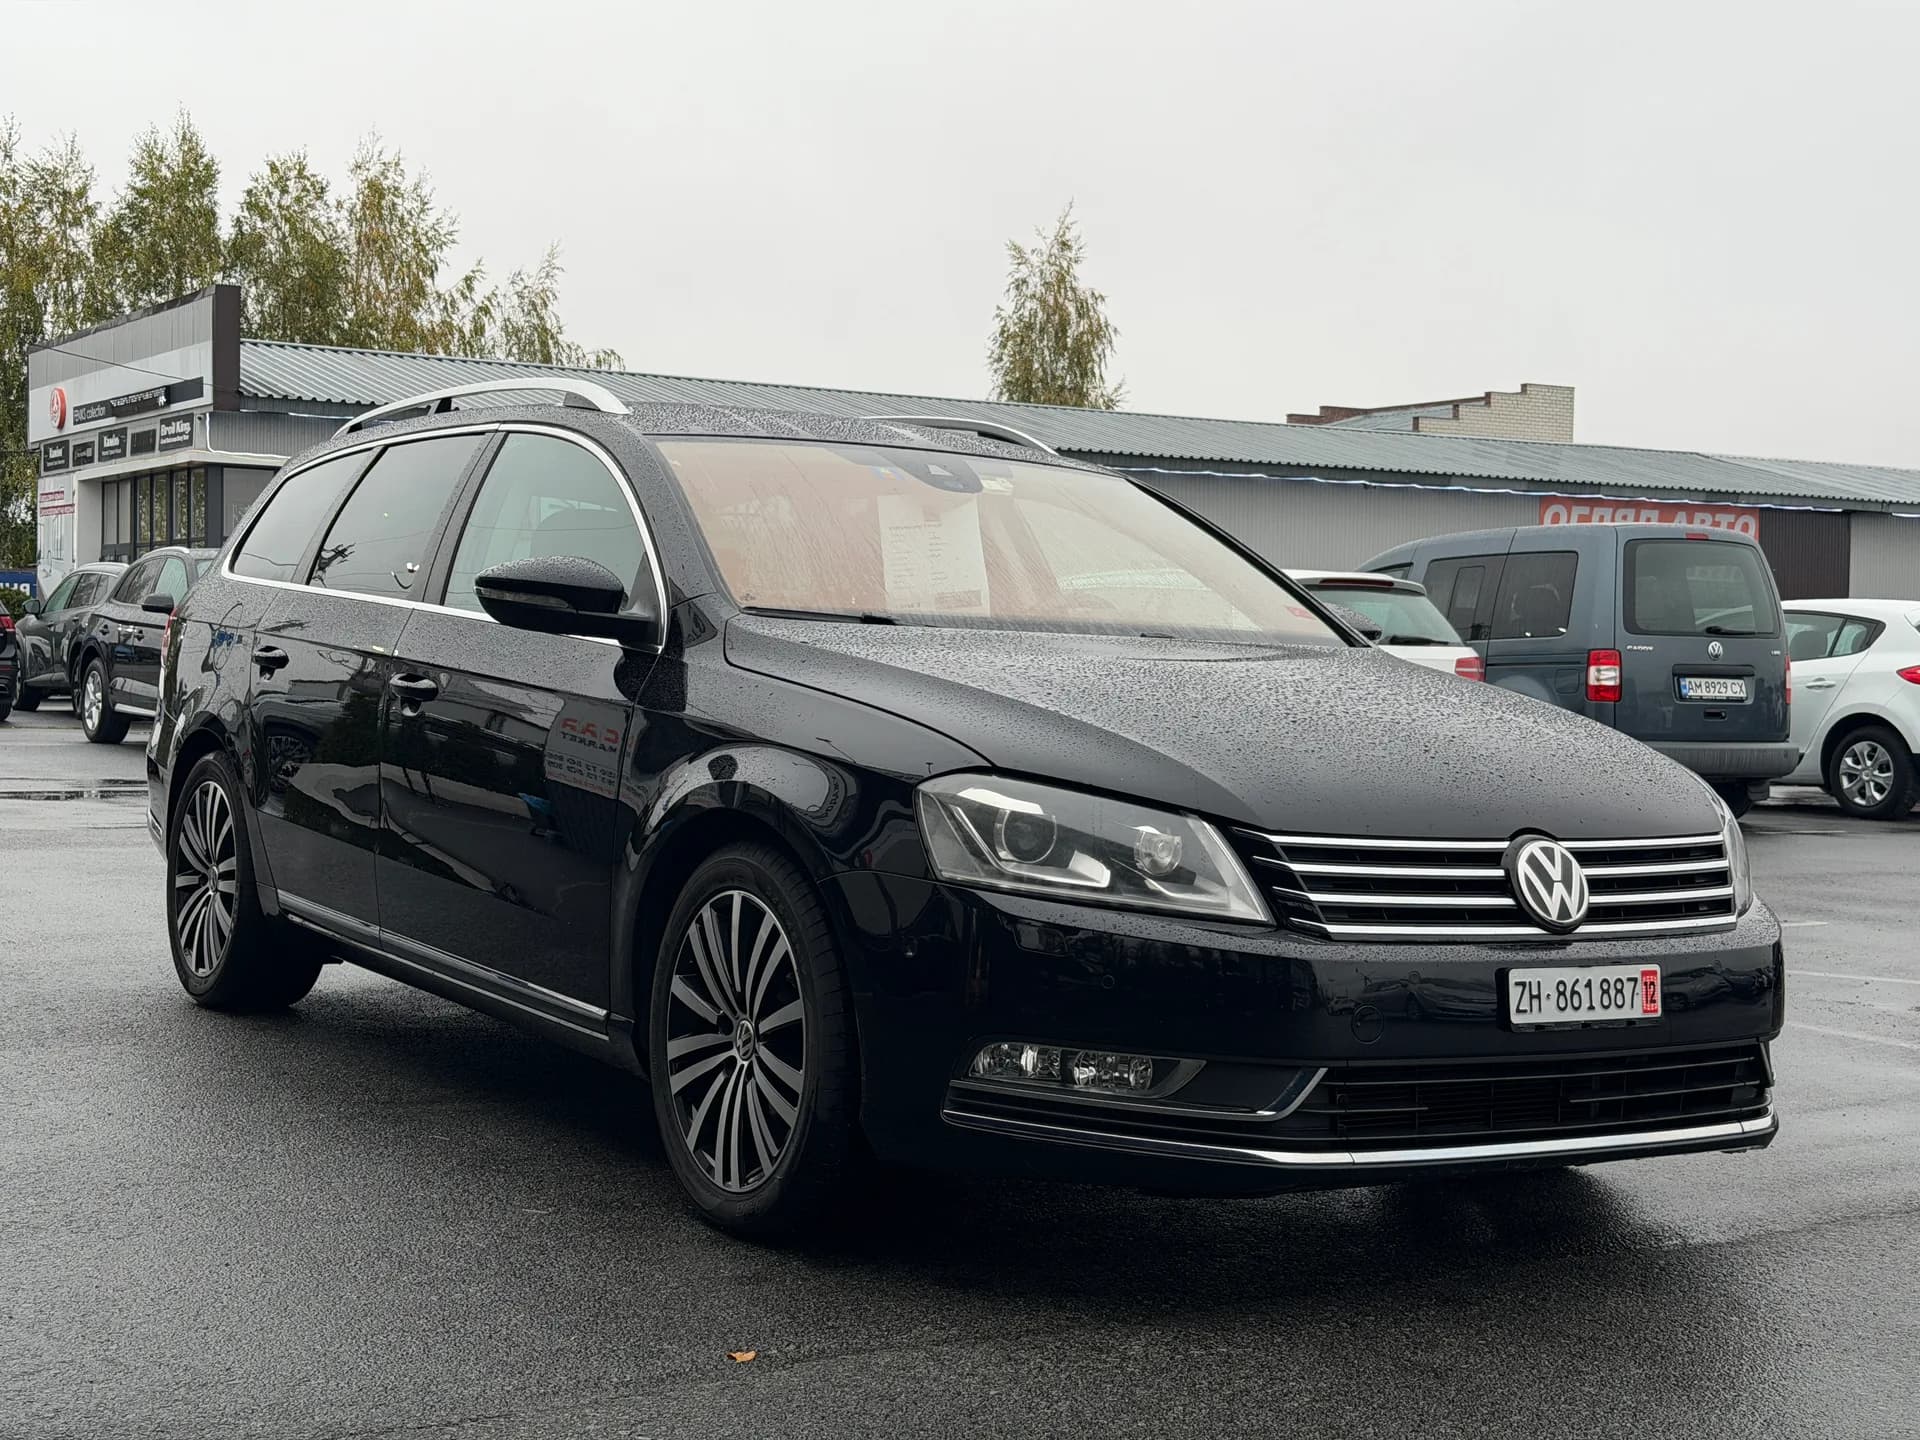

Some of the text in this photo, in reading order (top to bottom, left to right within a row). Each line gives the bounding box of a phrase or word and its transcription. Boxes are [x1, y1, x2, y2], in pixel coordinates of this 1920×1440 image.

[1672, 511, 1756, 537] АВТО
[1688, 681, 1745, 695] AM 8929 CX
[1518, 841, 1589, 922] VW
[1643, 980, 1657, 1004] 12
